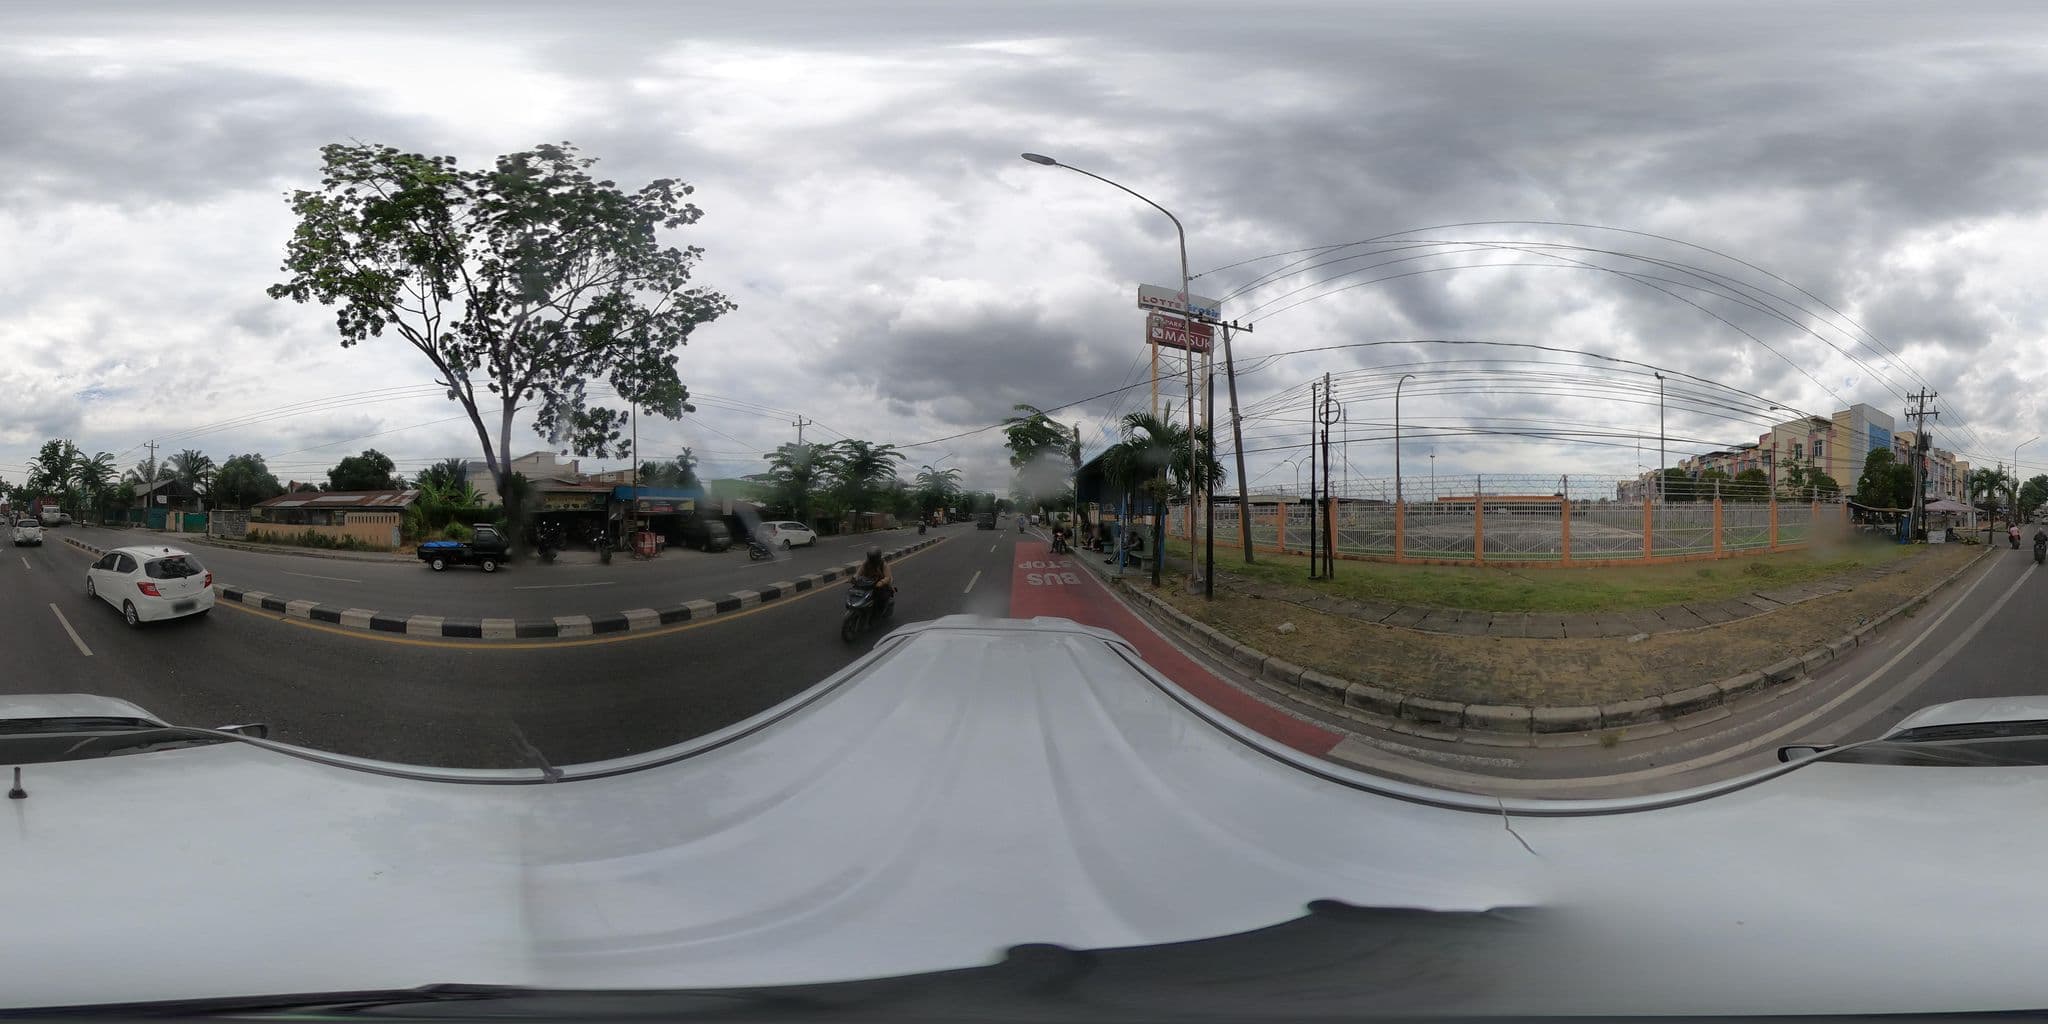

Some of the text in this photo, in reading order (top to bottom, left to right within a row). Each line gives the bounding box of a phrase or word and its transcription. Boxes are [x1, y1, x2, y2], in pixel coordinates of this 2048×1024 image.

[1142, 296, 1181, 308] LOTTE
[1165, 330, 1210, 348] MASUK
[1018, 560, 1073, 569] STOP
[1026, 572, 1081, 586] BUS
